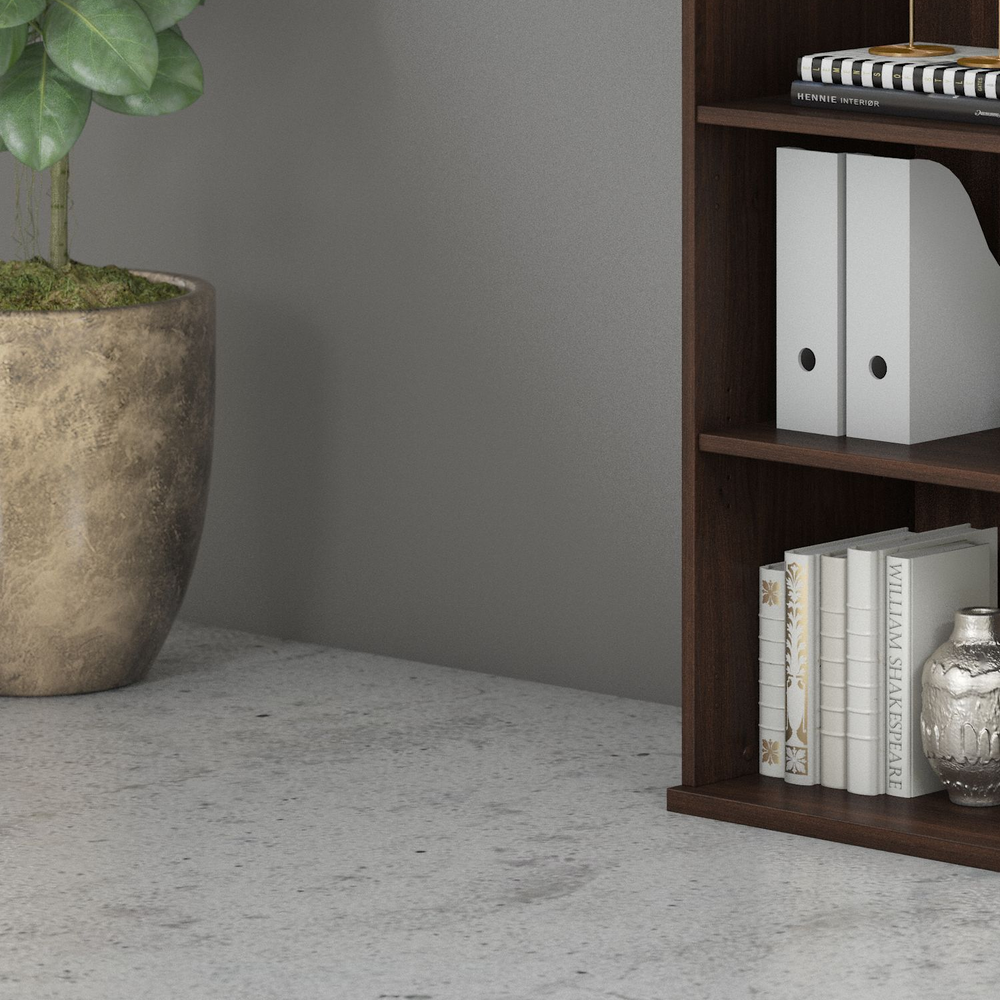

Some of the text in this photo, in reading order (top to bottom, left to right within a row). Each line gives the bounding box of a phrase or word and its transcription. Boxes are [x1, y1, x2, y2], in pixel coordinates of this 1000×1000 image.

[797, 92, 880, 108] HENNIE INTERIØR
[889, 563, 903, 790] WILLIAM SHAKESPEARE
